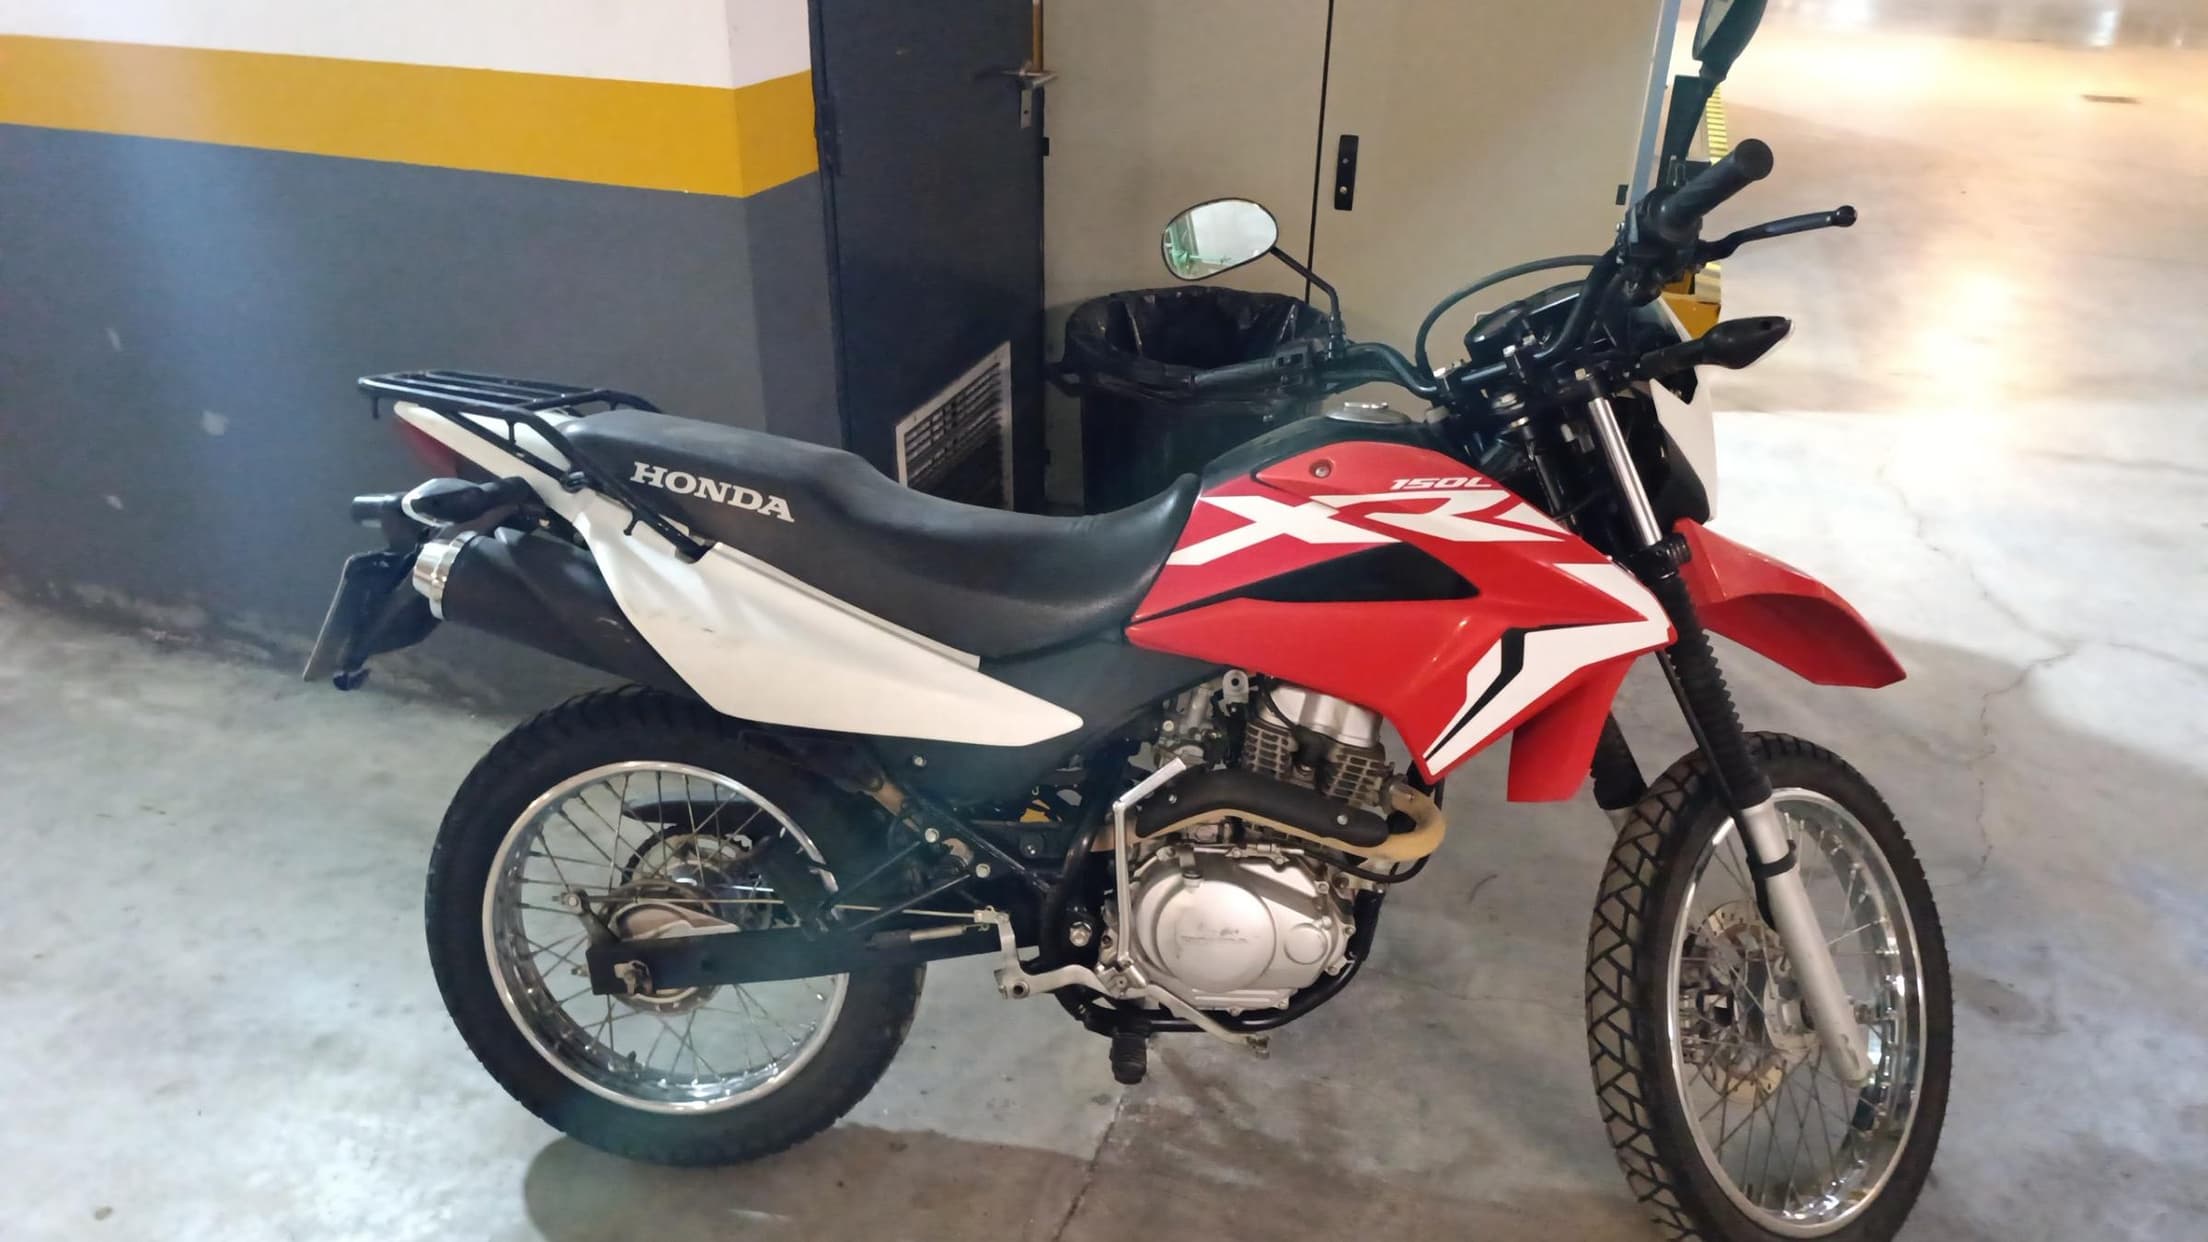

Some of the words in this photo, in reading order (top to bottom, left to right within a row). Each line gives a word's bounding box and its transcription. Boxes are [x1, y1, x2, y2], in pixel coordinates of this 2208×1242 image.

[630, 461, 795, 523] HONDA
[1390, 476, 1493, 491] 150L
[1167, 489, 1568, 566] XR
